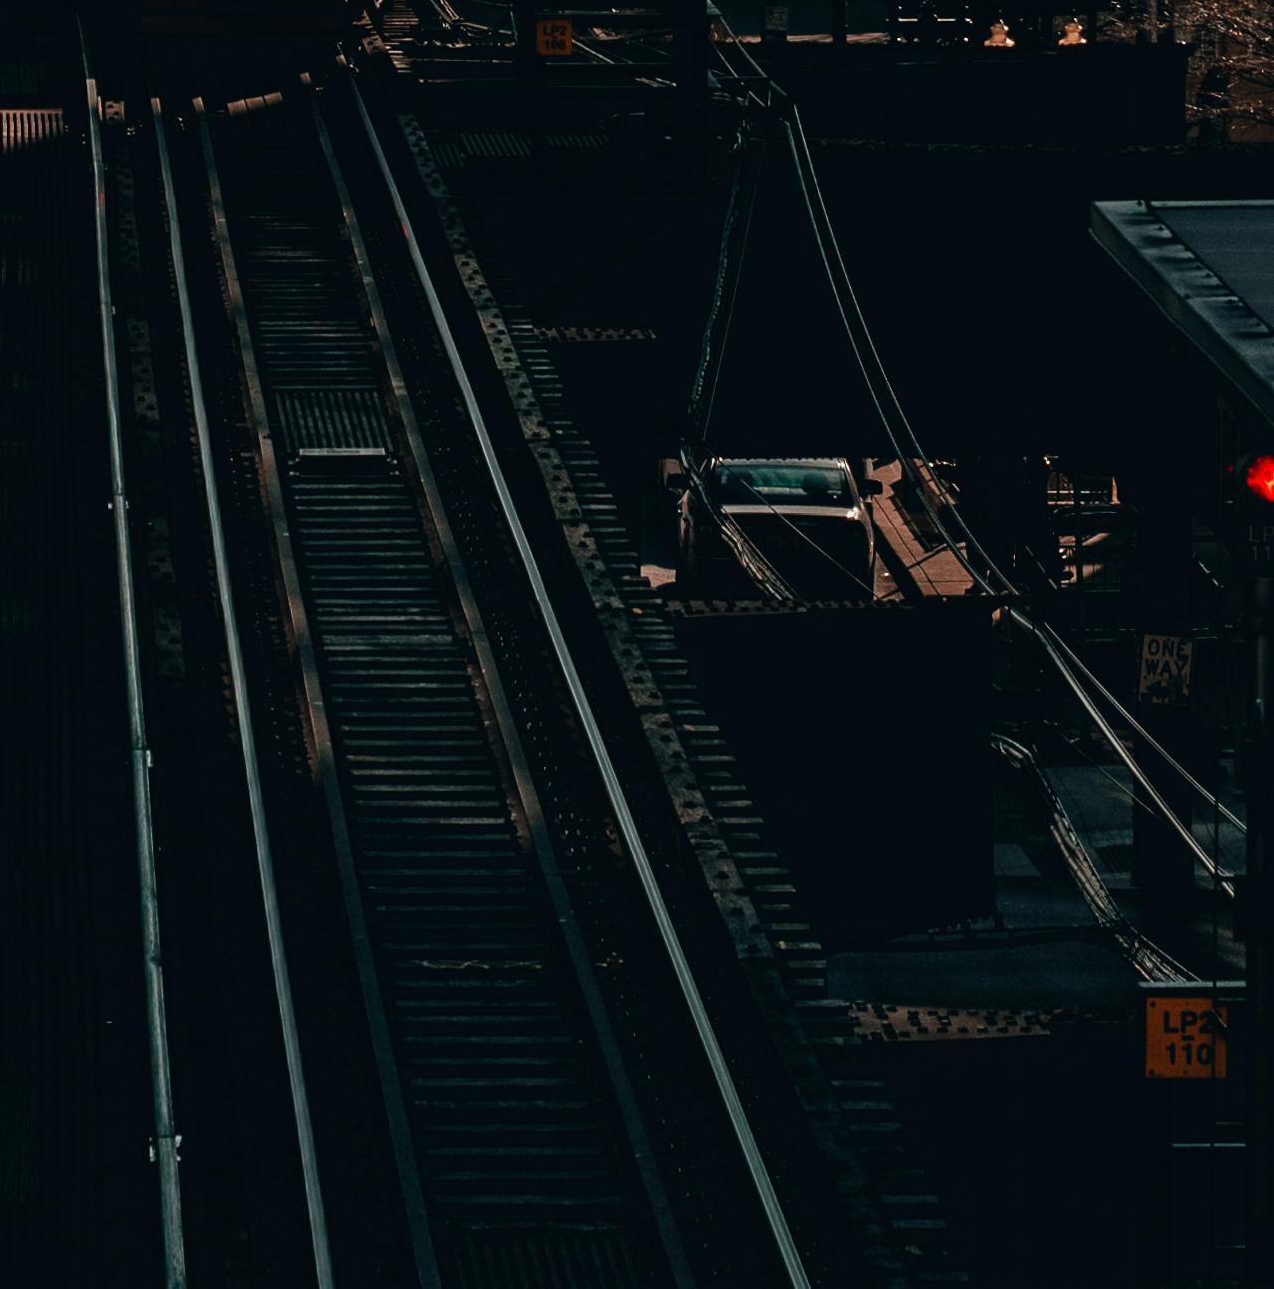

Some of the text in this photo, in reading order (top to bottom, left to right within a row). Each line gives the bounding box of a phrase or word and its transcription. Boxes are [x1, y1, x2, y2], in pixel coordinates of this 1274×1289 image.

[542, 24, 567, 36] LP2
[1147, 638, 1189, 658] ONE
[1146, 658, 1187, 679] WAY
[1163, 1010, 1215, 1034] LP2
[1166, 1043, 1215, 1065] 110
